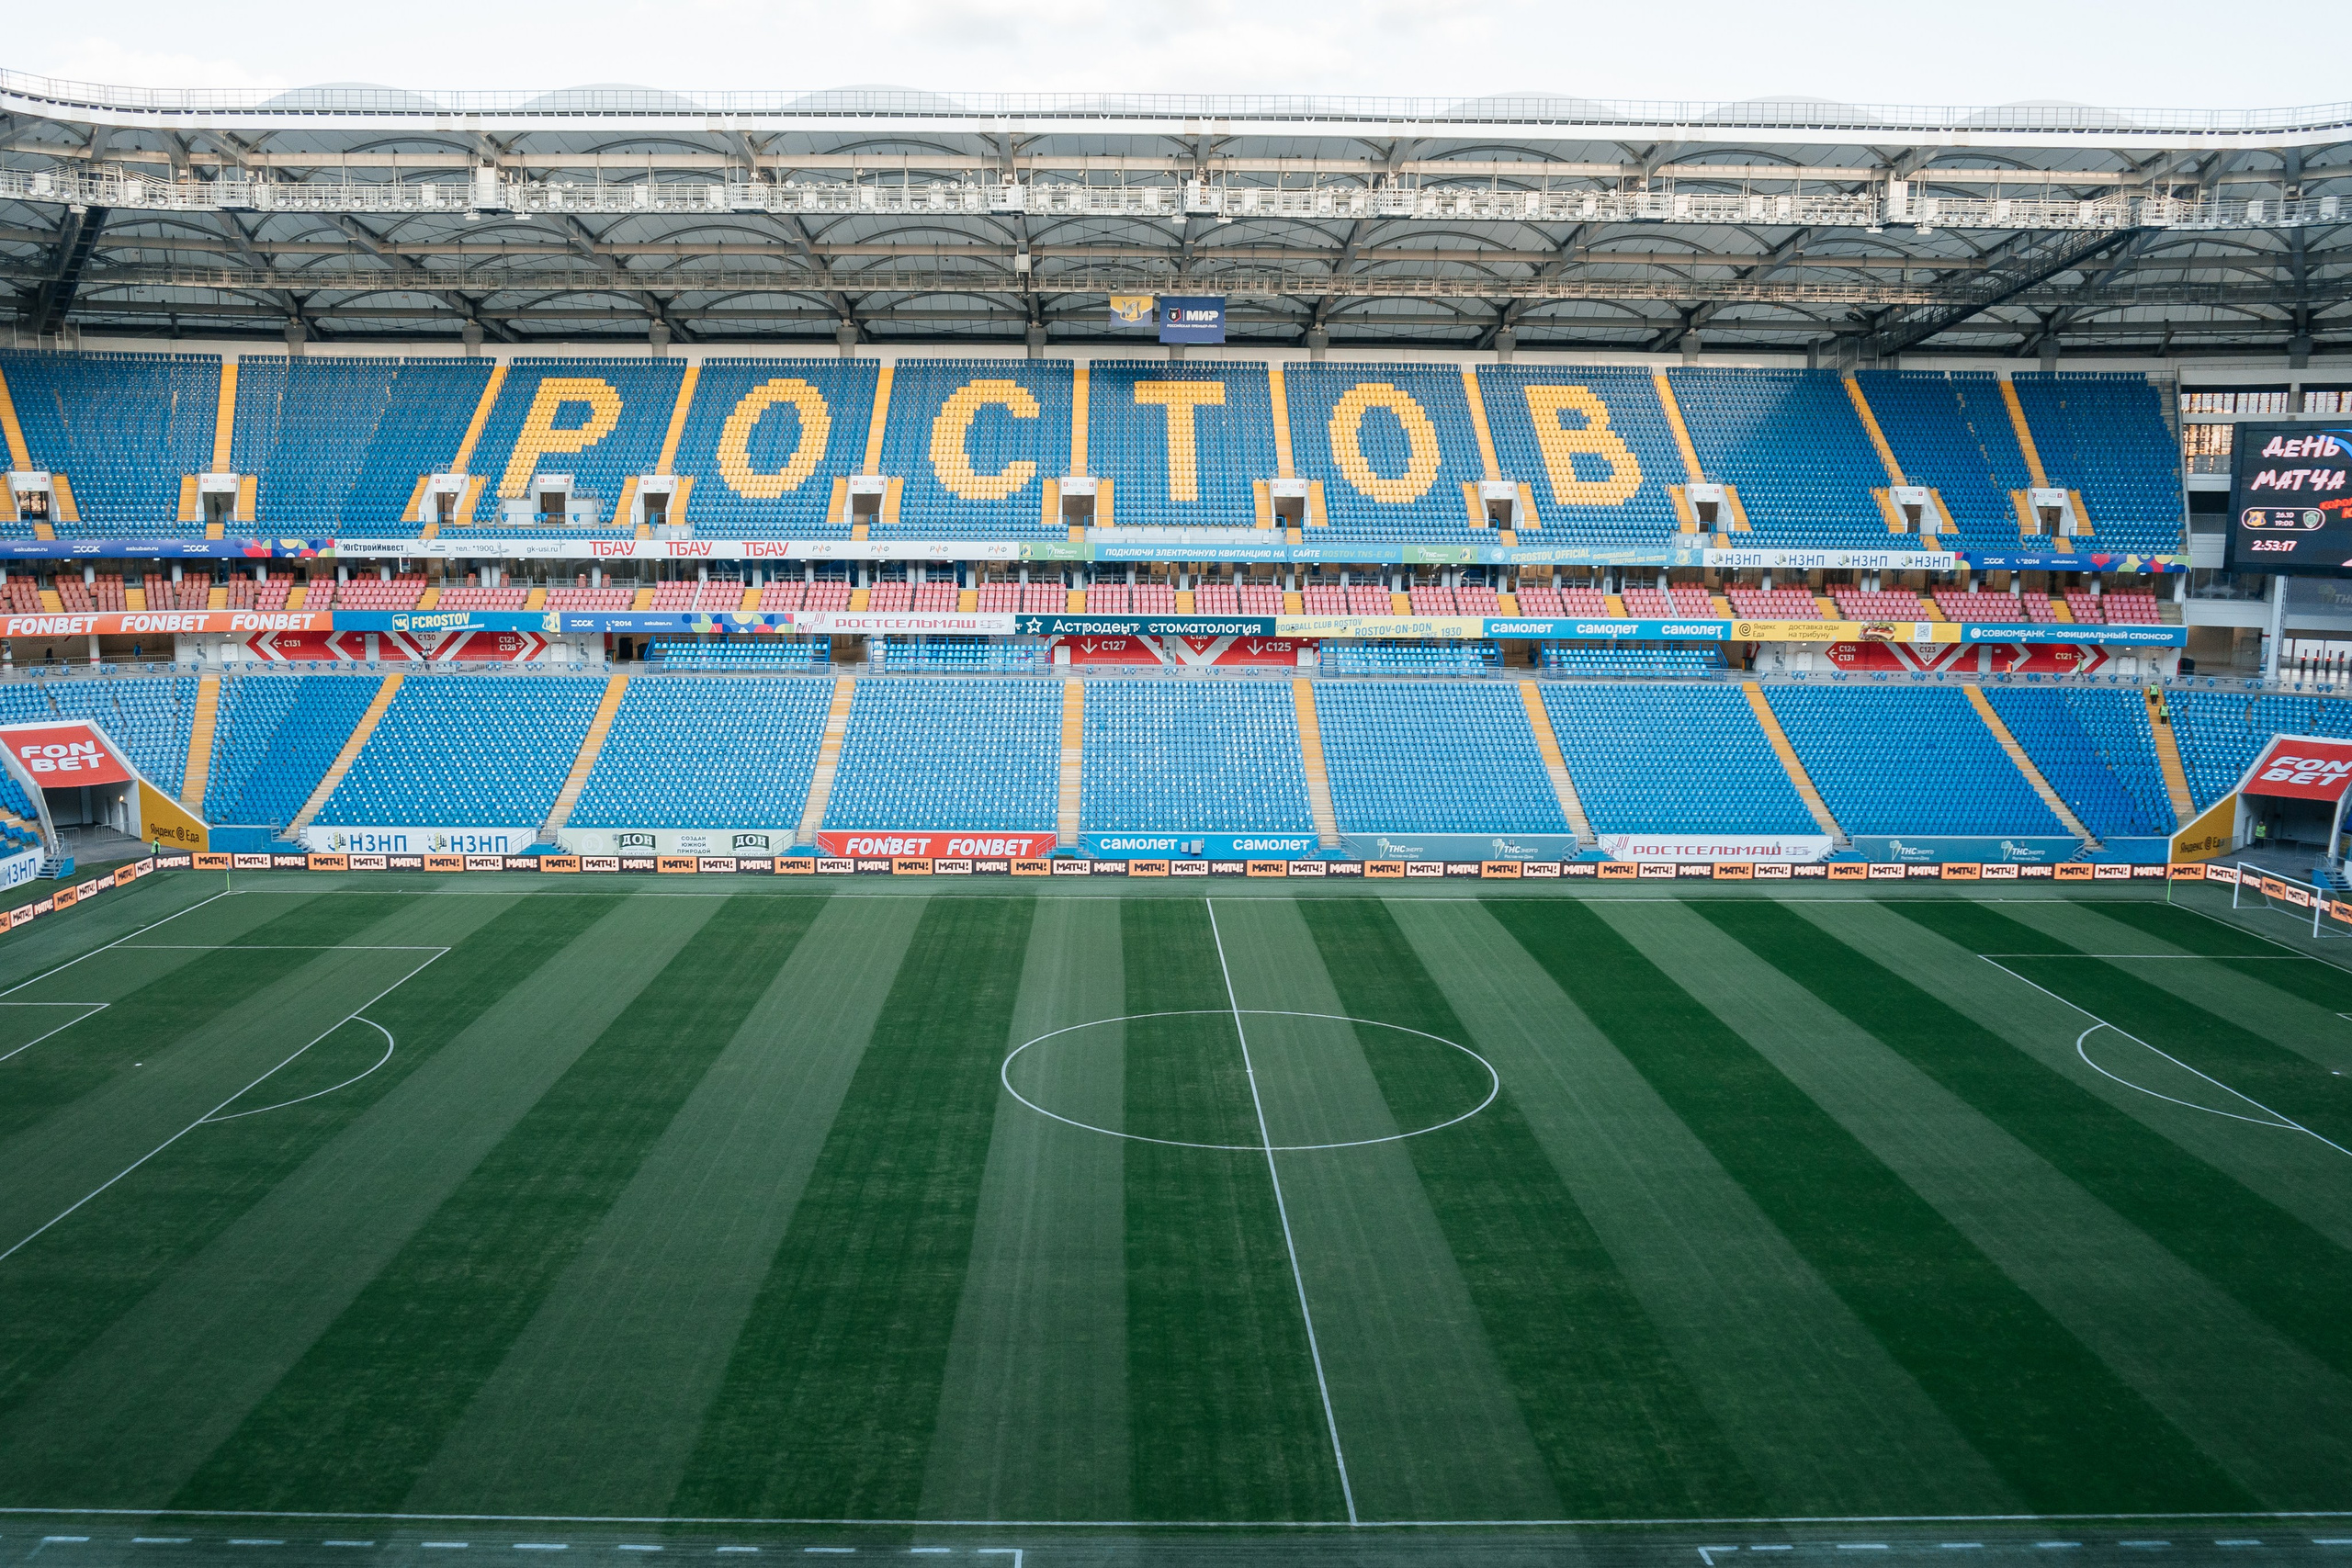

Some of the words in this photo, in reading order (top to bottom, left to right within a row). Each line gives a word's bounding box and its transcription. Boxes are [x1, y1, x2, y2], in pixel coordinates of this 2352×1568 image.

[1186, 310, 1219, 321] МИР
[497, 378, 1644, 505] РОСТОВ
[2262, 435, 2340, 458] ДЕНЬ
[2251, 469, 2346, 491] МАТЧА
[343, 543, 403, 552] ЮгСтройИнвест
[589, 541, 636, 555] ТБАУ
[665, 542, 713, 556] ТБАУ
[742, 542, 789, 556] ТБАУ
[2251, 540, 2297, 552] 2:53:17
[1105, 548, 1154, 557] ПОДКЛЮЧИ
[1156, 549, 1216, 557] ЭЛЕКТРОННУЮ
[1218, 550, 1272, 558] КВИТАНЦИЮ
[1293, 549, 1320, 558] САЙТЕ
[1322, 550, 1396, 558] ROSTOV.TNS-E.RU
[1510, 549, 1590, 563] FCROSTOV_OFFICIAL
[1725, 554, 1761, 565] НЗНП
[1789, 555, 1825, 565] НЗНП
[1852, 556, 1888, 566] НЗНП
[1915, 557, 1951, 567] НЗНП
[7, 617, 98, 635] FONBET
[121, 615, 209, 632] FONBET
[231, 613, 316, 630] FONBET
[412, 613, 470, 629] FCROSTOV
[836, 619, 976, 628] РОСТСЕЛЬМАШ
[1277, 622, 1312, 632] FOOTBALL
[1334, 619, 1363, 627] ROSTOV
[1053, 619, 1139, 635] Астродент
[1149, 623, 1261, 634] стоматология
[1355, 623, 1432, 636] ROSTOV-ON-DON
[1442, 627, 1462, 637] 1930
[1491, 623, 1553, 633] самолет
[1577, 624, 1639, 634] самолет
[1662, 625, 1724, 636] самолет
[1982, 629, 2045, 638] СОВКОМБАНК
[2057, 630, 2127, 640] ОФИЦИАЛЬНЫЙ
[2129, 632, 2173, 640] СПОНСОР
[1102, 641, 1126, 650] C127
[1266, 642, 1291, 652] C125
[21, 741, 96, 758] FON
[31, 753, 104, 772] BET
[2269, 756, 2352, 773] FON
[2260, 768, 2350, 786] BET
[150, 823, 175, 837] Яндекс
[186, 831, 199, 842] Еда
[350, 834, 407, 852] НЗНП
[451, 835, 508, 852] НЗНП
[622, 835, 653, 846] ДОН
[736, 835, 766, 846] ДОН
[1100, 838, 1177, 850] самолет
[1233, 838, 1310, 851] самолет
[846, 838, 932, 855] FONBET
[947, 839, 1033, 856] FONBET
[1633, 846, 1781, 855] РОСТСЕЛЬМАШ
[157, 857, 190, 868] МАТЧ!
[198, 857, 228, 865] МАТЧ!
[275, 857, 305, 866] МАТЧ!
[390, 857, 421, 867] МАТЧ!
[858, 861, 890, 870] МАТЧ!
[976, 862, 1007, 871] МАТЧ!
[1370, 865, 1400, 873] МАТЧ!
[1447, 864, 1479, 874] МАТЧ!
[1564, 865, 1595, 874] МАТЧ!
[1947, 867, 1976, 875] МАТЧ!
[2022, 866, 2052, 876] МАТЧ!
[2133, 866, 2165, 876] МАТЧ!
